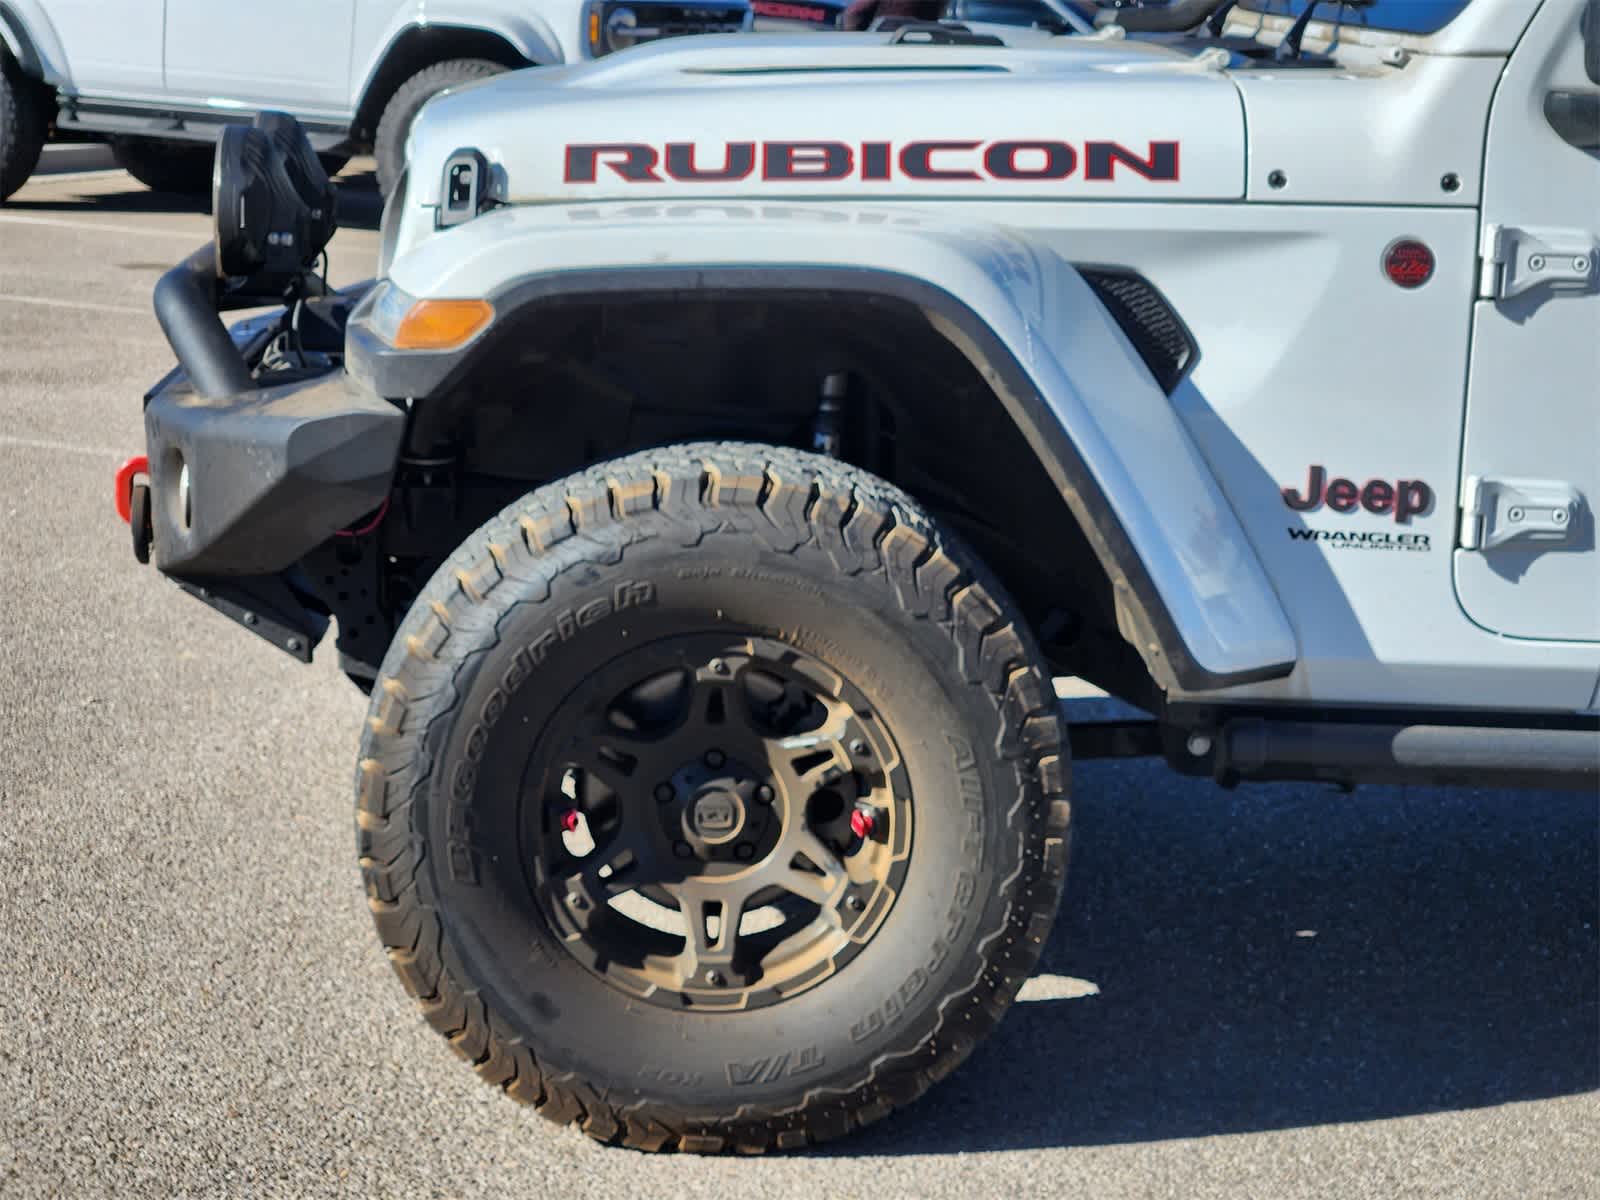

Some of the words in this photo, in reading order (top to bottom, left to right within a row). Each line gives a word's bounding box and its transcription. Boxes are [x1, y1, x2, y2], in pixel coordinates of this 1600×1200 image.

[563, 140, 1180, 184] RUBICON
[1281, 465, 1431, 524] Jeep
[1287, 528, 1431, 545] WRANGLER
[724, 1044, 826, 1087] T/A
